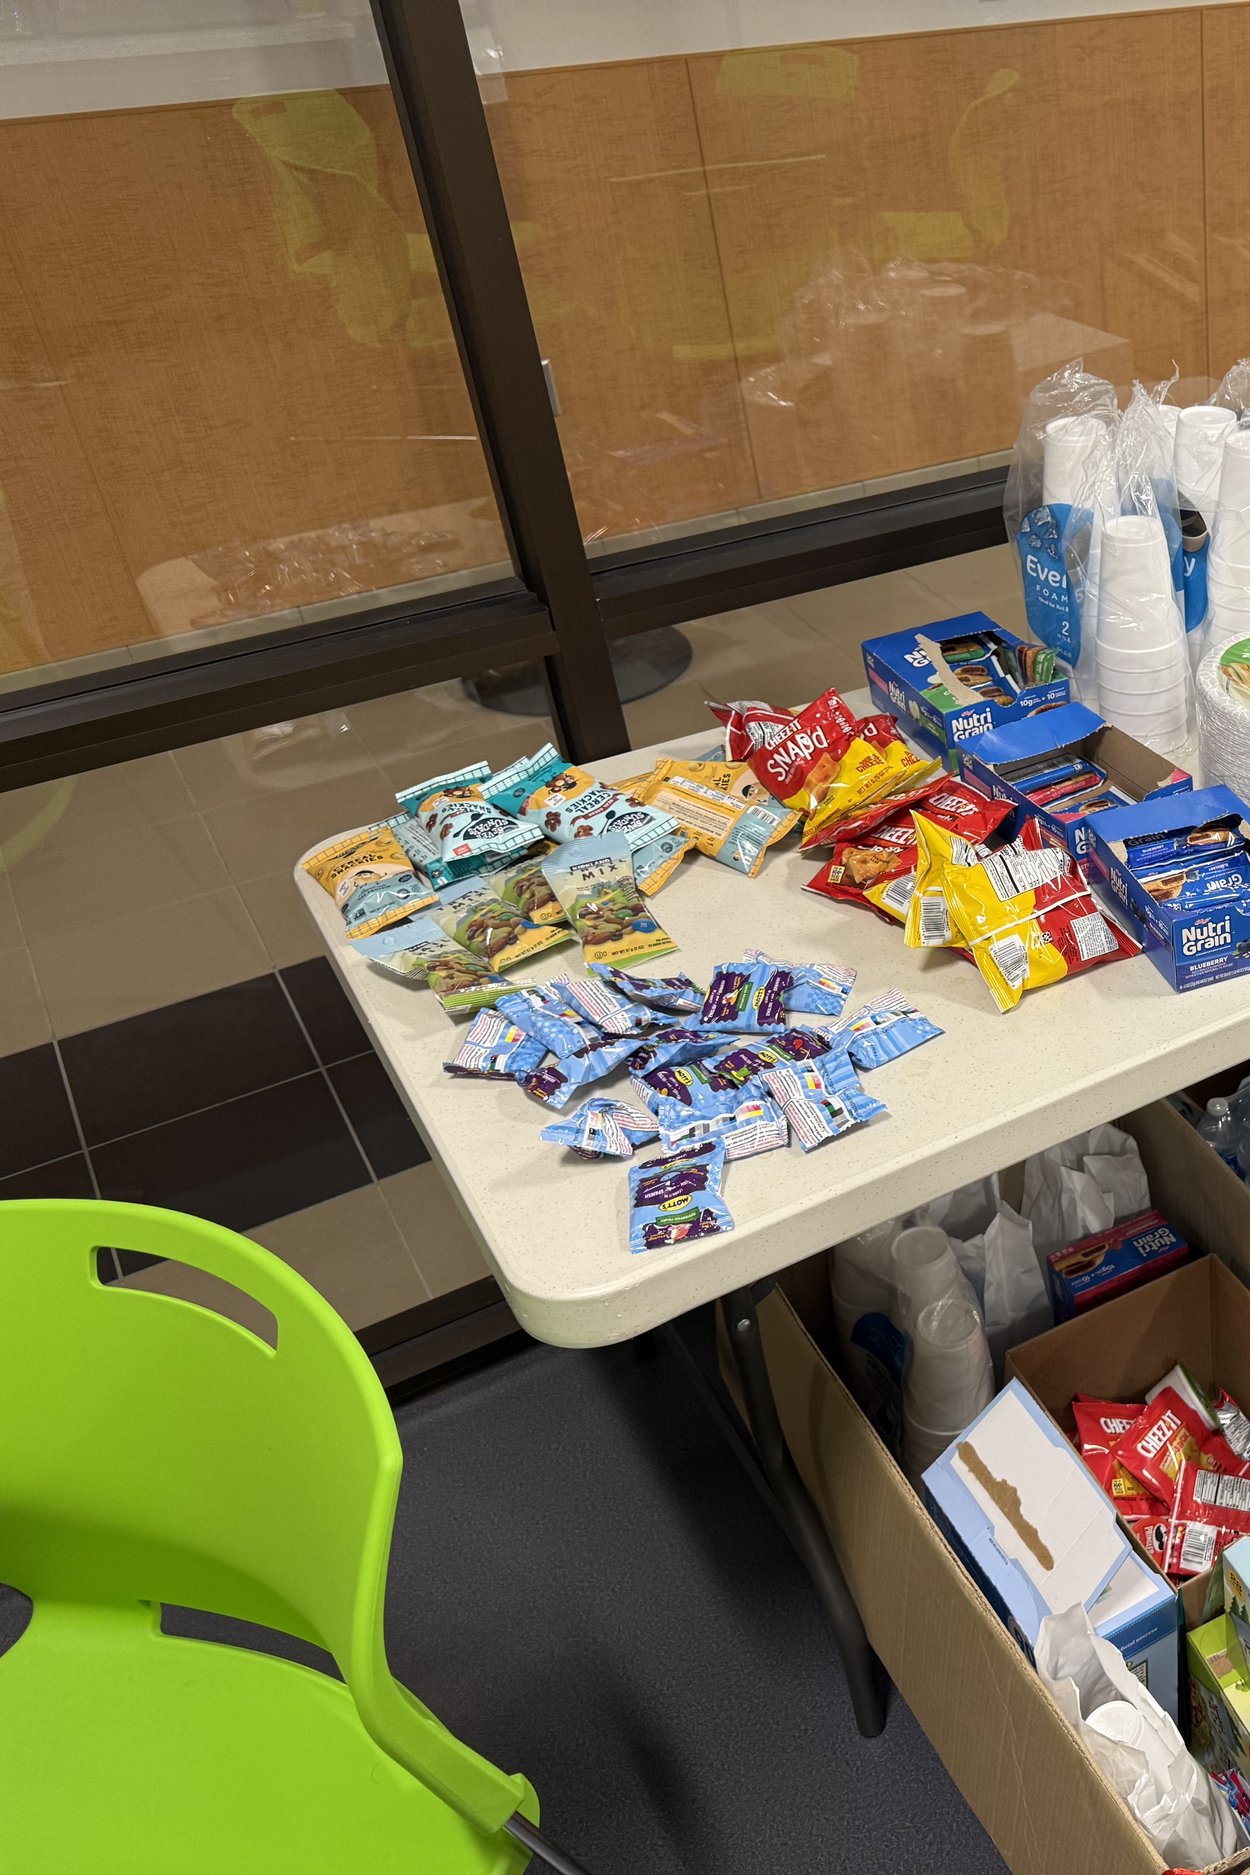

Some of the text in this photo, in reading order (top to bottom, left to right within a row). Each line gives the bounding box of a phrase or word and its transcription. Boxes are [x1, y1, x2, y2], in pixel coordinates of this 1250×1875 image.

[1036, 584, 1069, 603] FOAM
[1020, 698, 1033, 707] 10g
[951, 707, 993, 733] Nutri
[953, 722, 994, 742] Grain
[575, 792, 611, 815] CEREAL
[572, 858, 611, 871] KIRKLAND
[582, 864, 618, 881] MIX
[1181, 915, 1231, 945] Nutri
[1182, 932, 1232, 956] Grain
[1189, 956, 1229, 972] BLUEBERRY
[761, 1051, 777, 1063] MOTT'S
[676, 1069, 692, 1085] MOTT'S
[644, 1189, 664, 1199] SPANISH
[662, 1196, 691, 1210] MOTT'S
[1132, 1227, 1170, 1247] Grain
[1138, 1233, 1177, 1257] Nutri
[1136, 1409, 1182, 1459] CHEEZ-IT
[1135, 1627, 1158, 1643] sources
